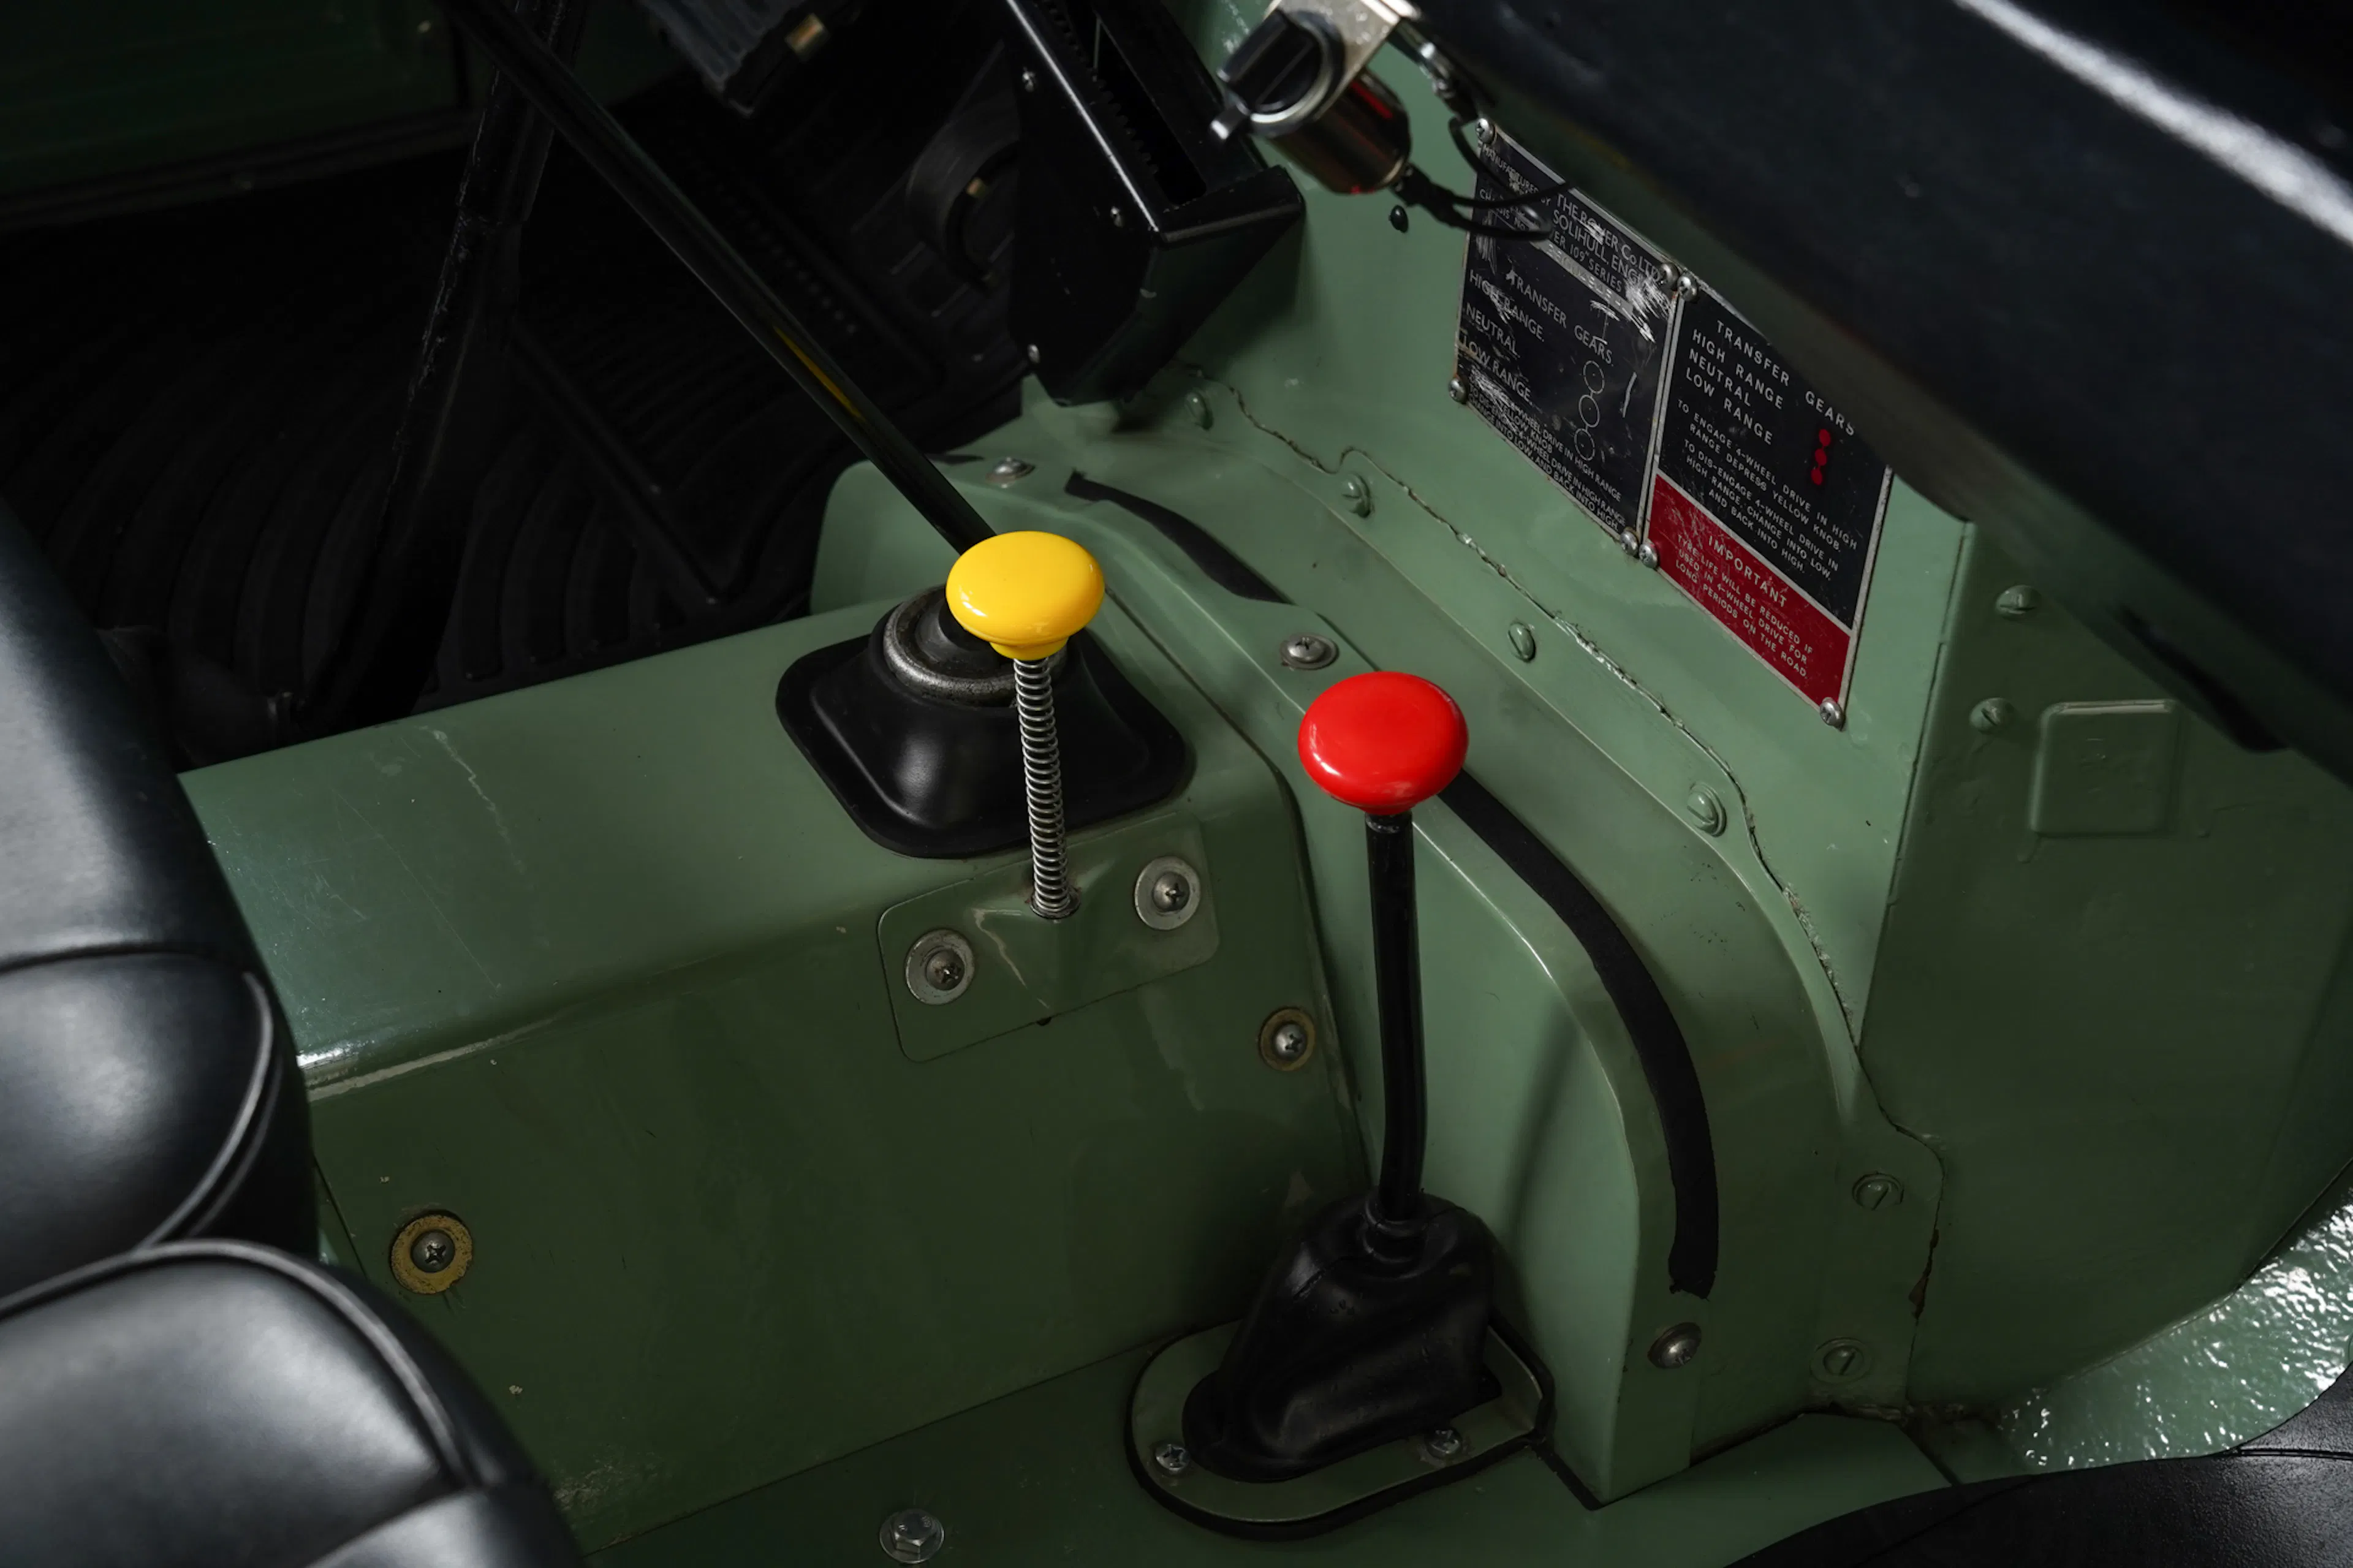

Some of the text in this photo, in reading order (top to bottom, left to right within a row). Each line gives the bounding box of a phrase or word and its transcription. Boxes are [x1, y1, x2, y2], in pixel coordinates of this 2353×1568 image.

[1557, 193, 1578, 219] THE
[1508, 270, 1567, 329] TRANSFER
[1588, 258, 1623, 293] SERIES
[1686, 367, 1773, 445] LOW RANGE
[1689, 348, 1751, 407] NEUTRAL
[1692, 328, 1783, 410] HIGH RANGE
[1717, 319, 1854, 436] TRANSFER GEARS
[1575, 492, 1596, 512] INTO
[1678, 399, 1858, 550] TO ENGAGE 4-WHEEL DRIVE IN HIGH
[1684, 438, 1839, 571] TO DIS-ENGAGE 4-WHEEL DRIVE IN
[1686, 454, 1708, 479] HIGH
[1746, 506, 1782, 539] CHANGE
[1786, 537, 1807, 559] INTO
[1689, 422, 1721, 454] RANGE
[1726, 453, 1767, 491] DEPRESS
[1772, 490, 1809, 525] YELLOW
[1708, 488, 1728, 508] AND
[1730, 506, 1754, 531] BACK
[1757, 528, 1778, 549] INTO
[1675, 559, 1697, 583] LONG
[1703, 583, 1738, 619] PERIODS
[1743, 619, 1756, 635] ON
[1760, 632, 1777, 652] THE
[1678, 534, 1813, 654] TYRE LIFE WILL BE REDUCED IF
[1679, 548, 1808, 665] USED IN 4-WHEEL DRIVE FOR
[1708, 536, 1787, 607] IMPORTANT
